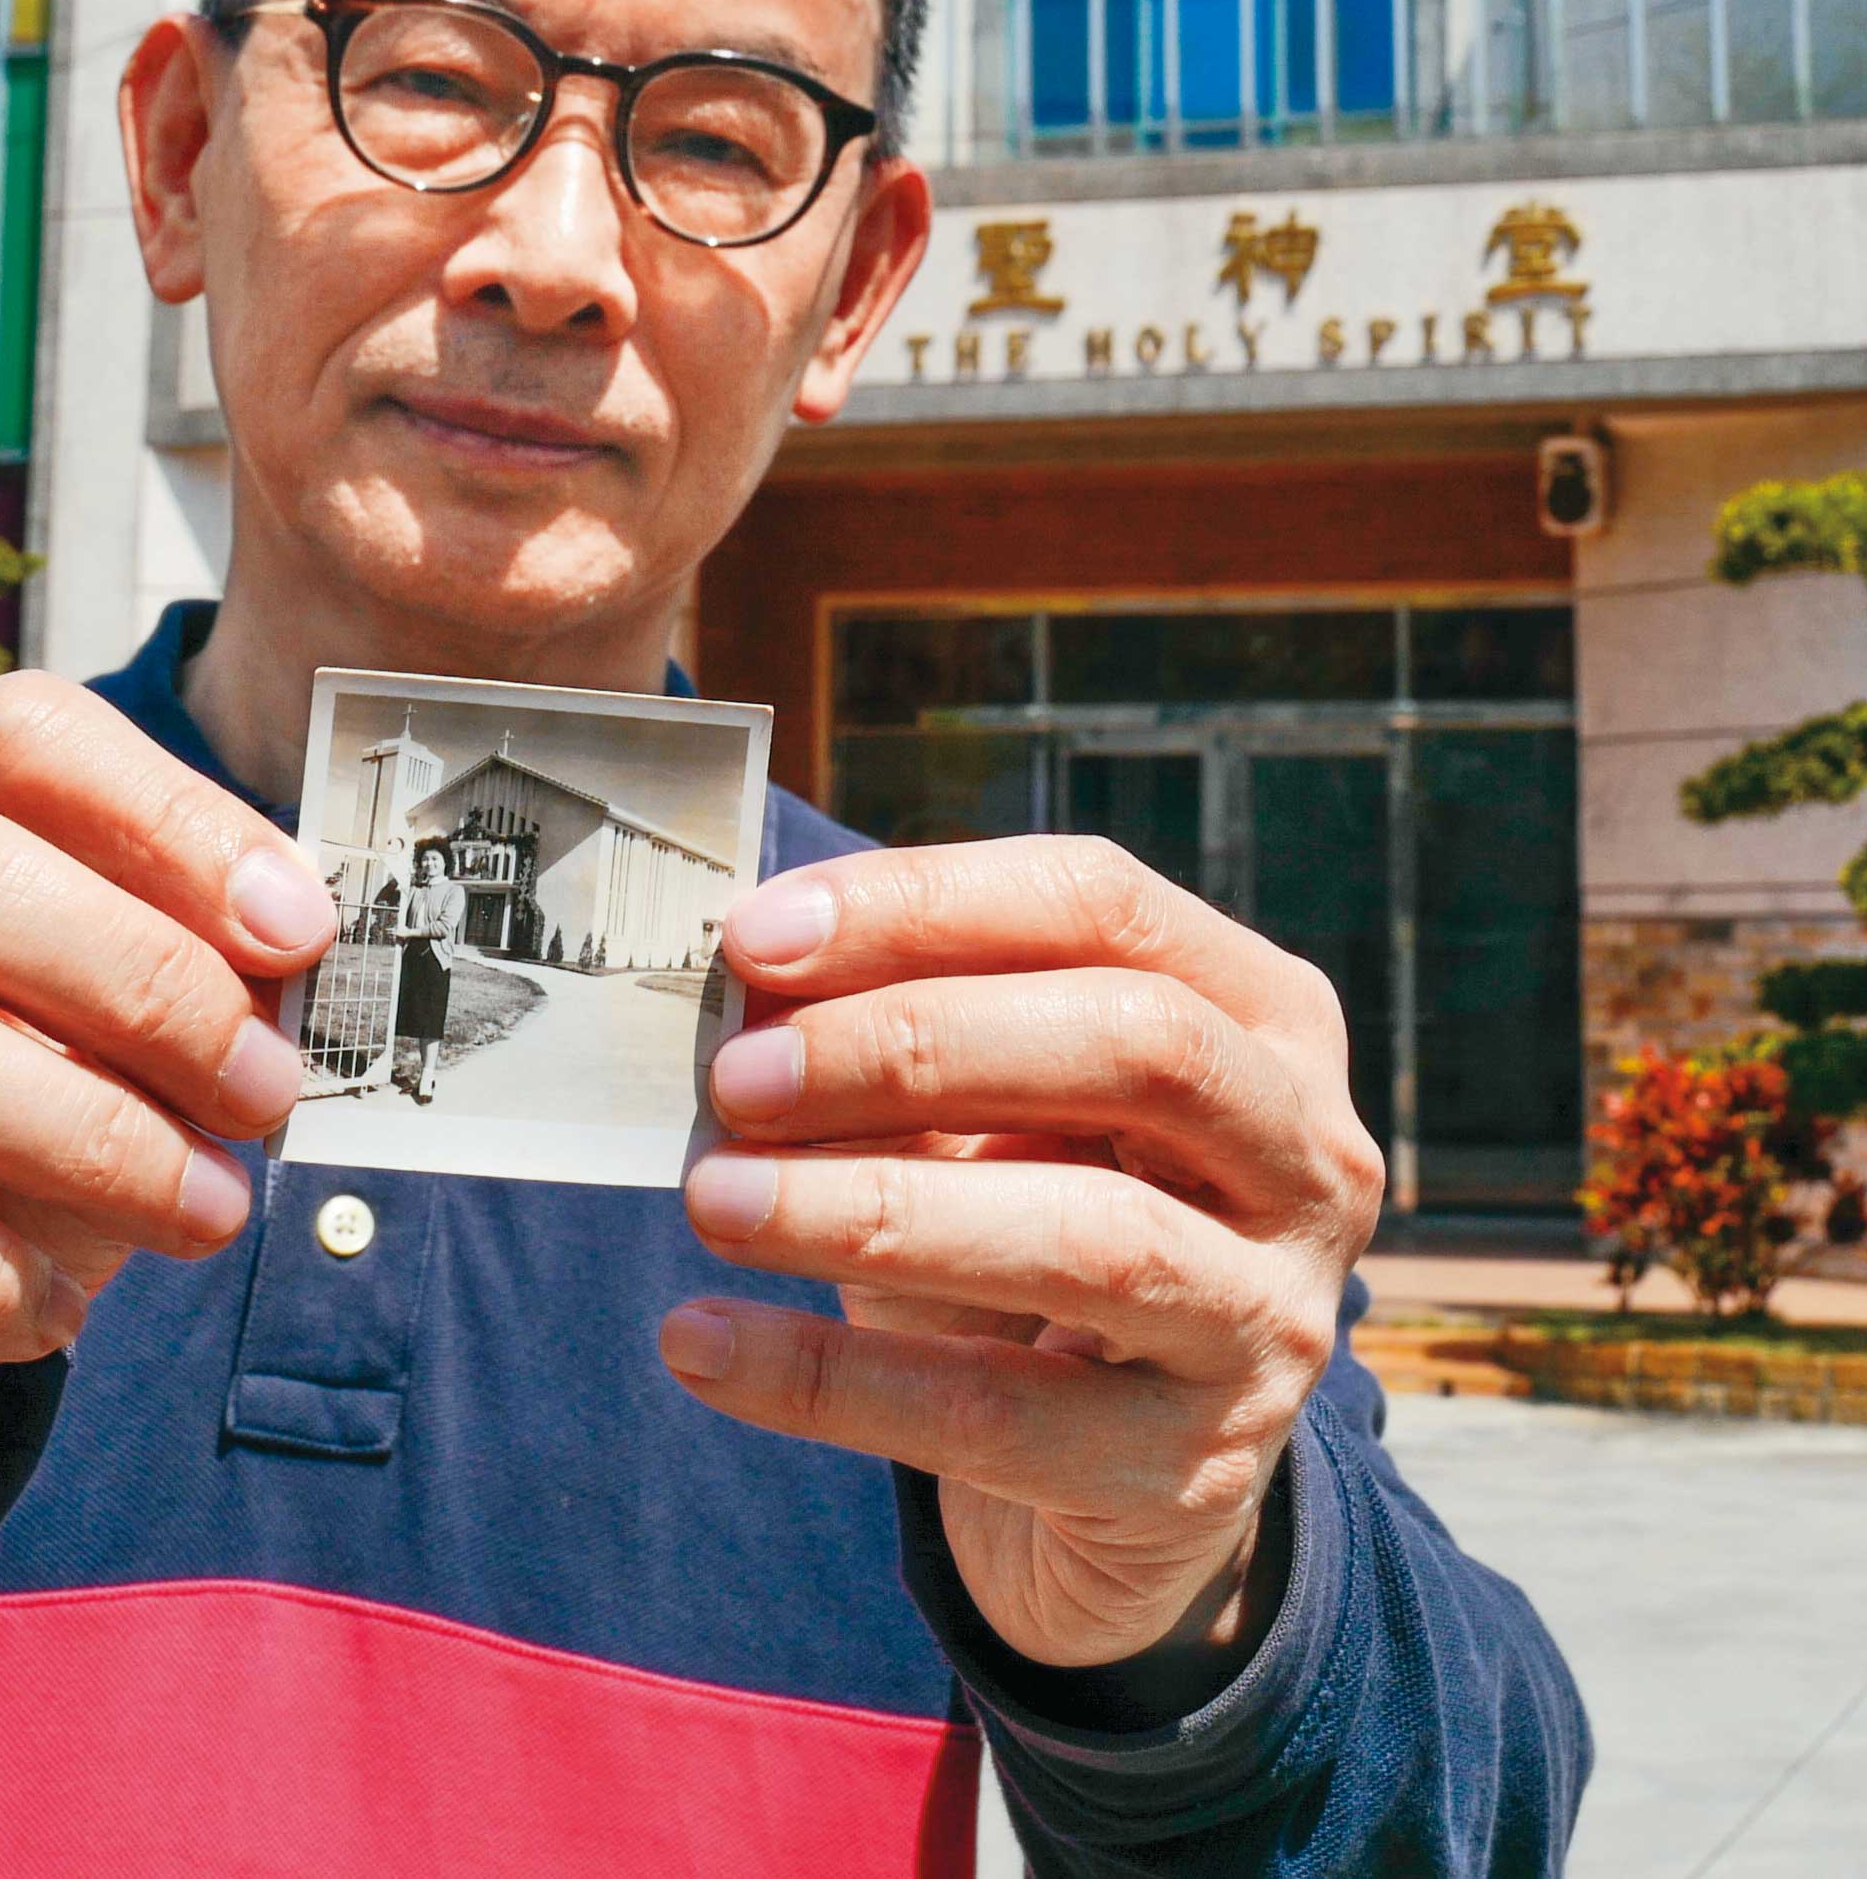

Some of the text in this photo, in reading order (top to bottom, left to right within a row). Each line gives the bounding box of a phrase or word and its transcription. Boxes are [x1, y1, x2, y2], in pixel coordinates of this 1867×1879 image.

[967, 198, 1589, 315] 聖神堂
[906, 304, 1592, 373] THE HOLY SPIRIT
